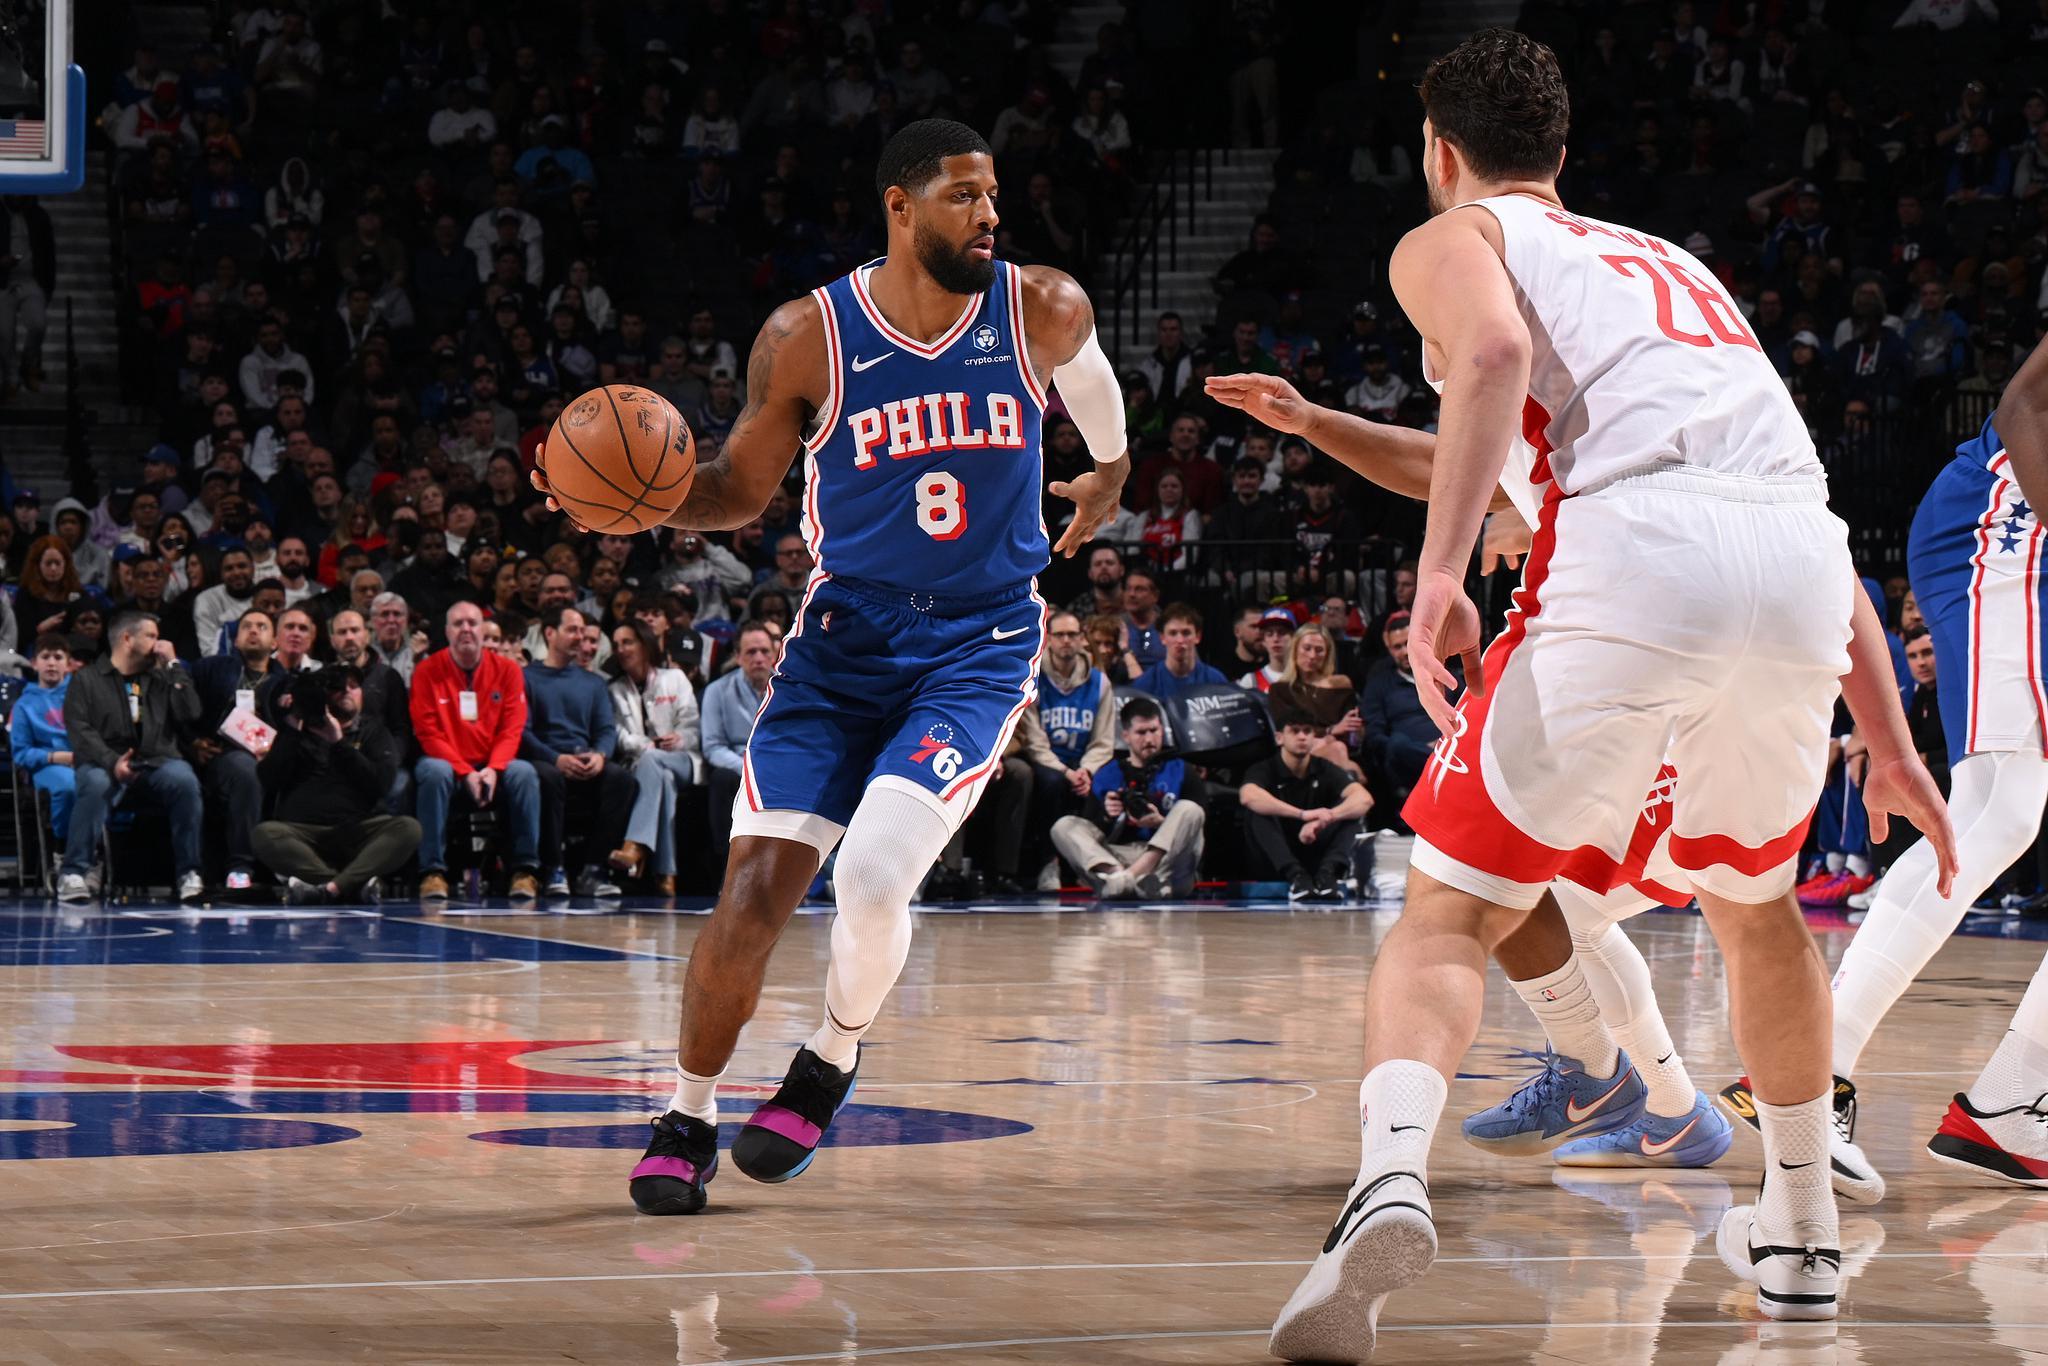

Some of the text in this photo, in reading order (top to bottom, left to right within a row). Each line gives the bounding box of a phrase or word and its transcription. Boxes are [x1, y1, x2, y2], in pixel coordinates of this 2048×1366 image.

[1598, 254, 1762, 353] 28
[964, 354, 1012, 366] crypto.com
[847, 392, 1026, 471] PHILA
[915, 471, 968, 541] 8
[1041, 706, 1094, 732] PHILA
[1186, 695, 1220, 715] NJM
